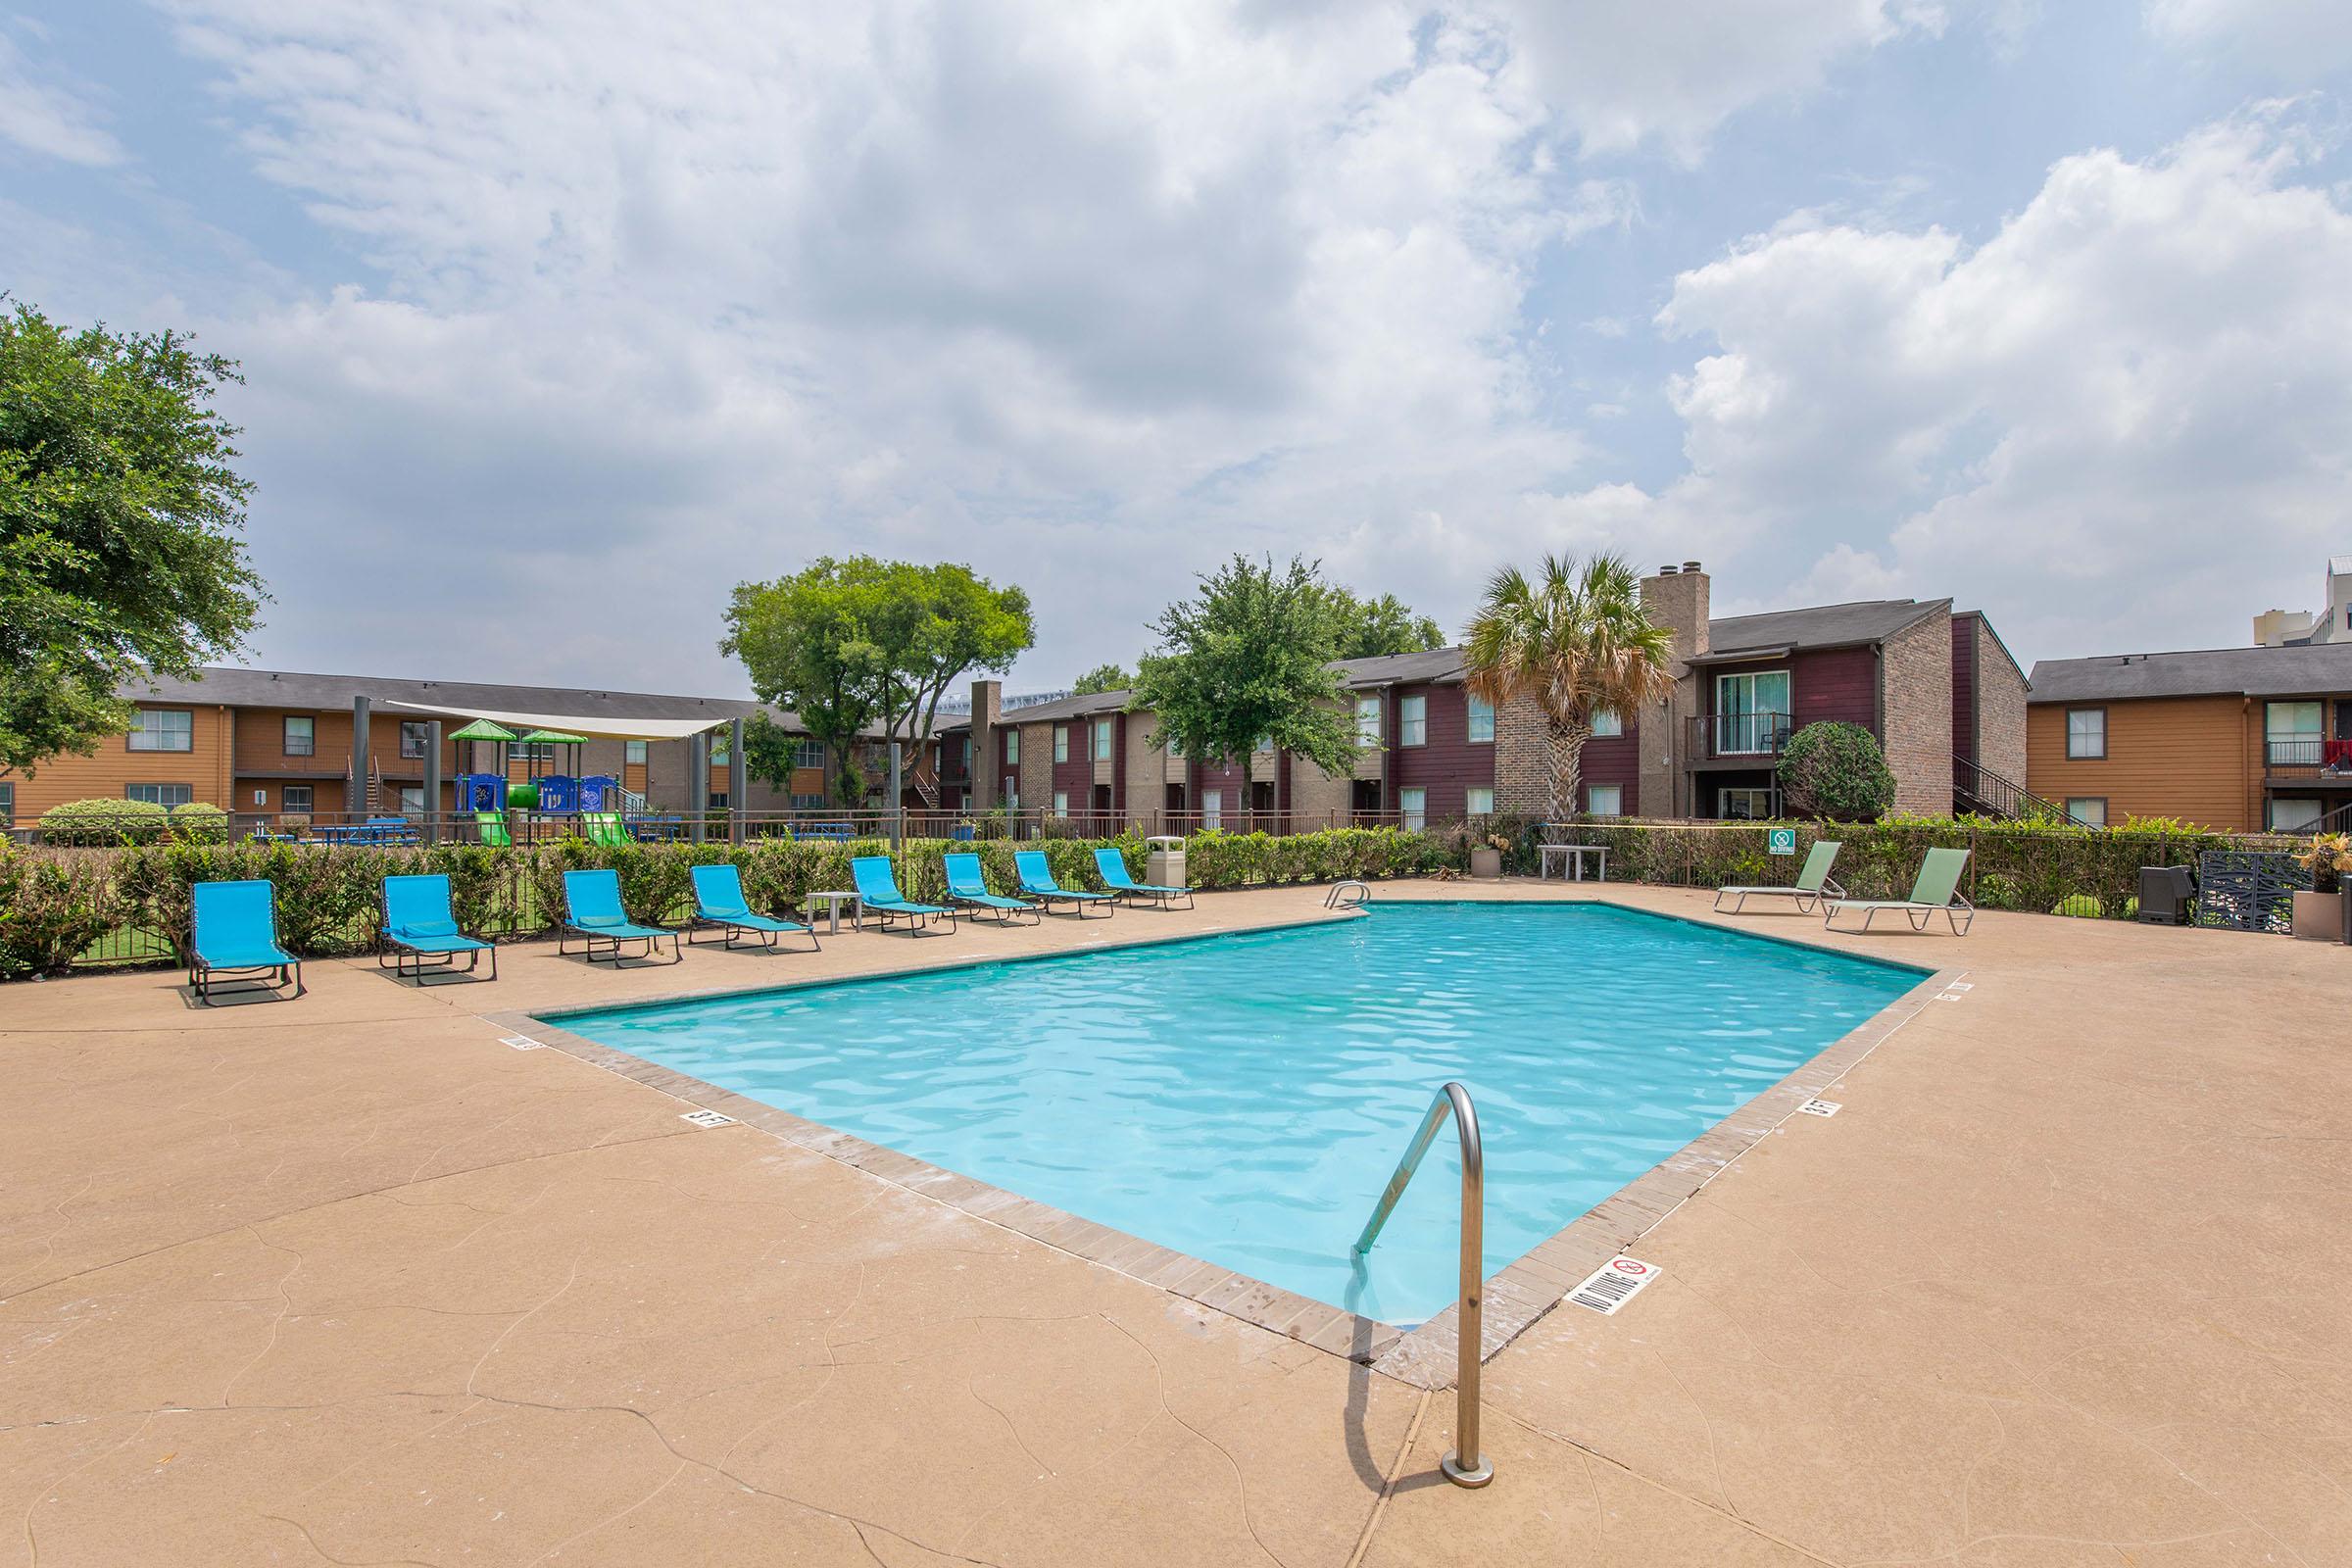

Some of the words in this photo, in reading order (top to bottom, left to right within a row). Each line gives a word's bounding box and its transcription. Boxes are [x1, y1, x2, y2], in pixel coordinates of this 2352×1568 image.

[699, 1116, 731, 1126] FT
[1585, 1272, 1639, 1301] DIVING
[1571, 1293, 1613, 1312] NO
